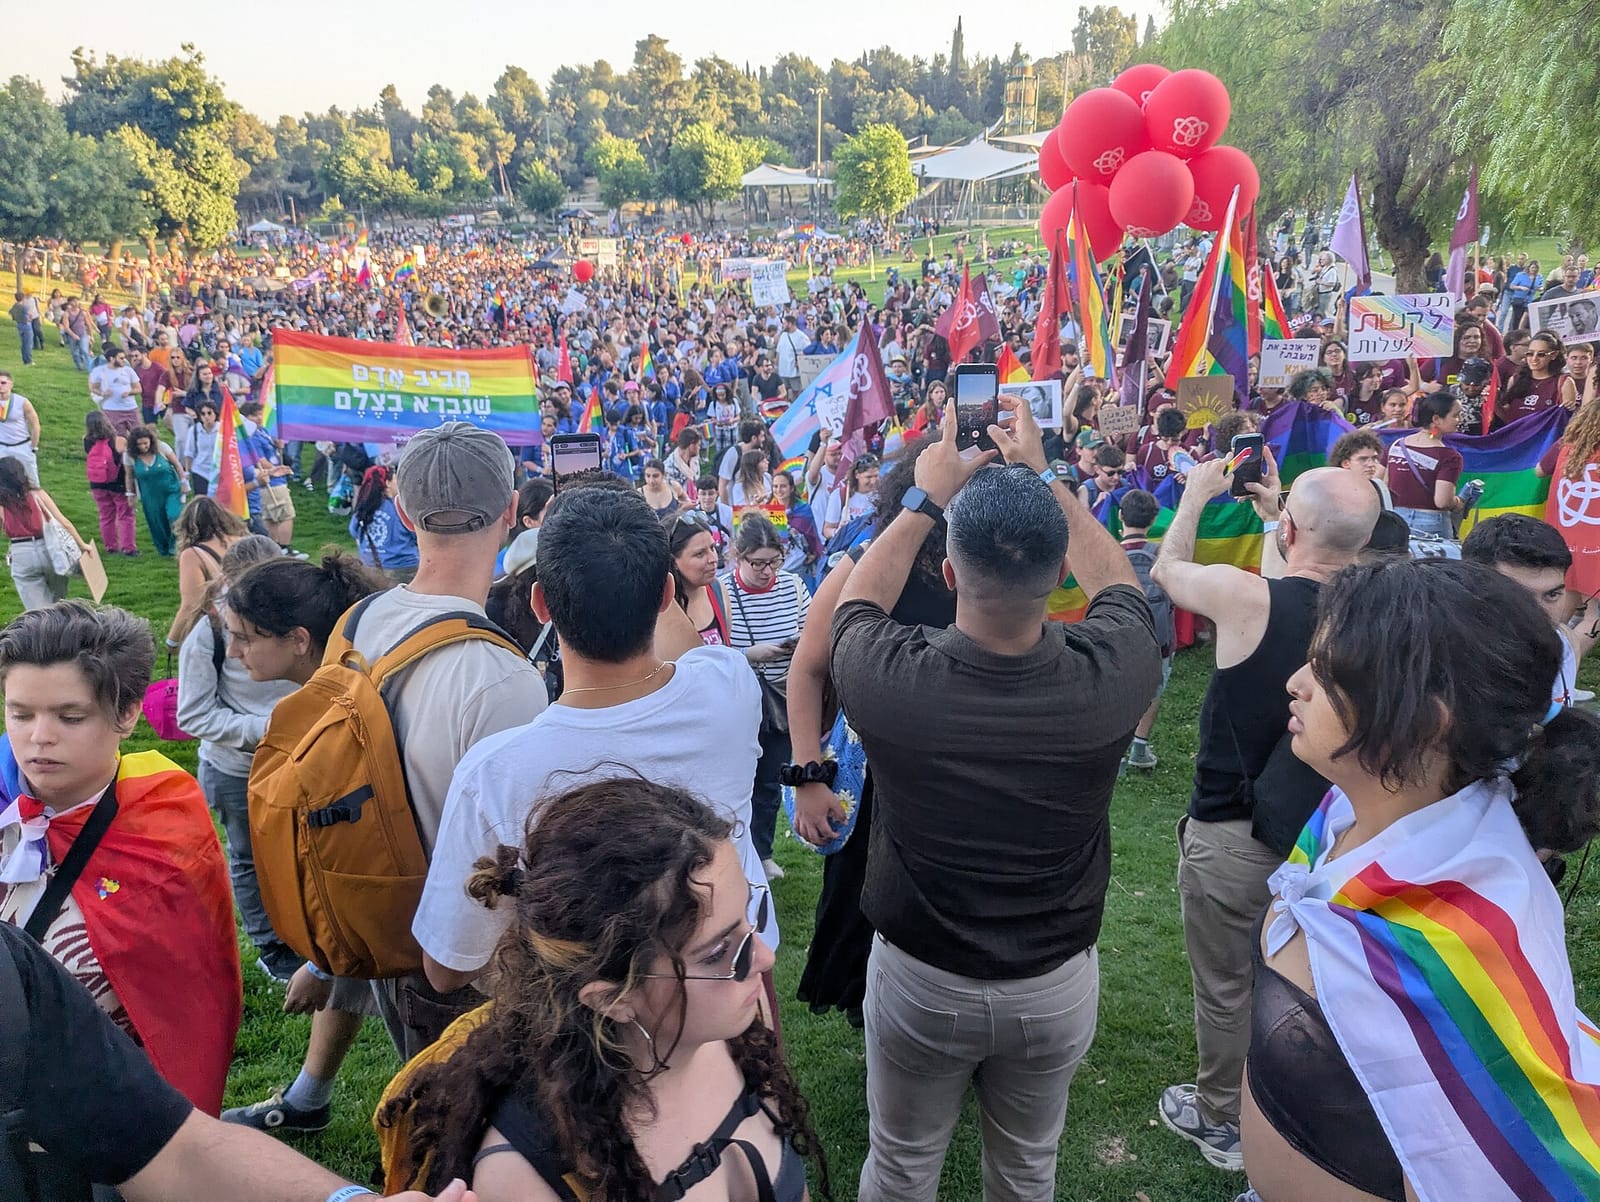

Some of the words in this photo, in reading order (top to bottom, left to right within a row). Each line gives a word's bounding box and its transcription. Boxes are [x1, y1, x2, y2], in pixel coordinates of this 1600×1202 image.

[1412, 296, 1450, 308] תנו
[1353, 309, 1443, 338] לקשת
[1352, 336, 1414, 354] לעלות
[1279, 350, 1314, 361] השבת?
